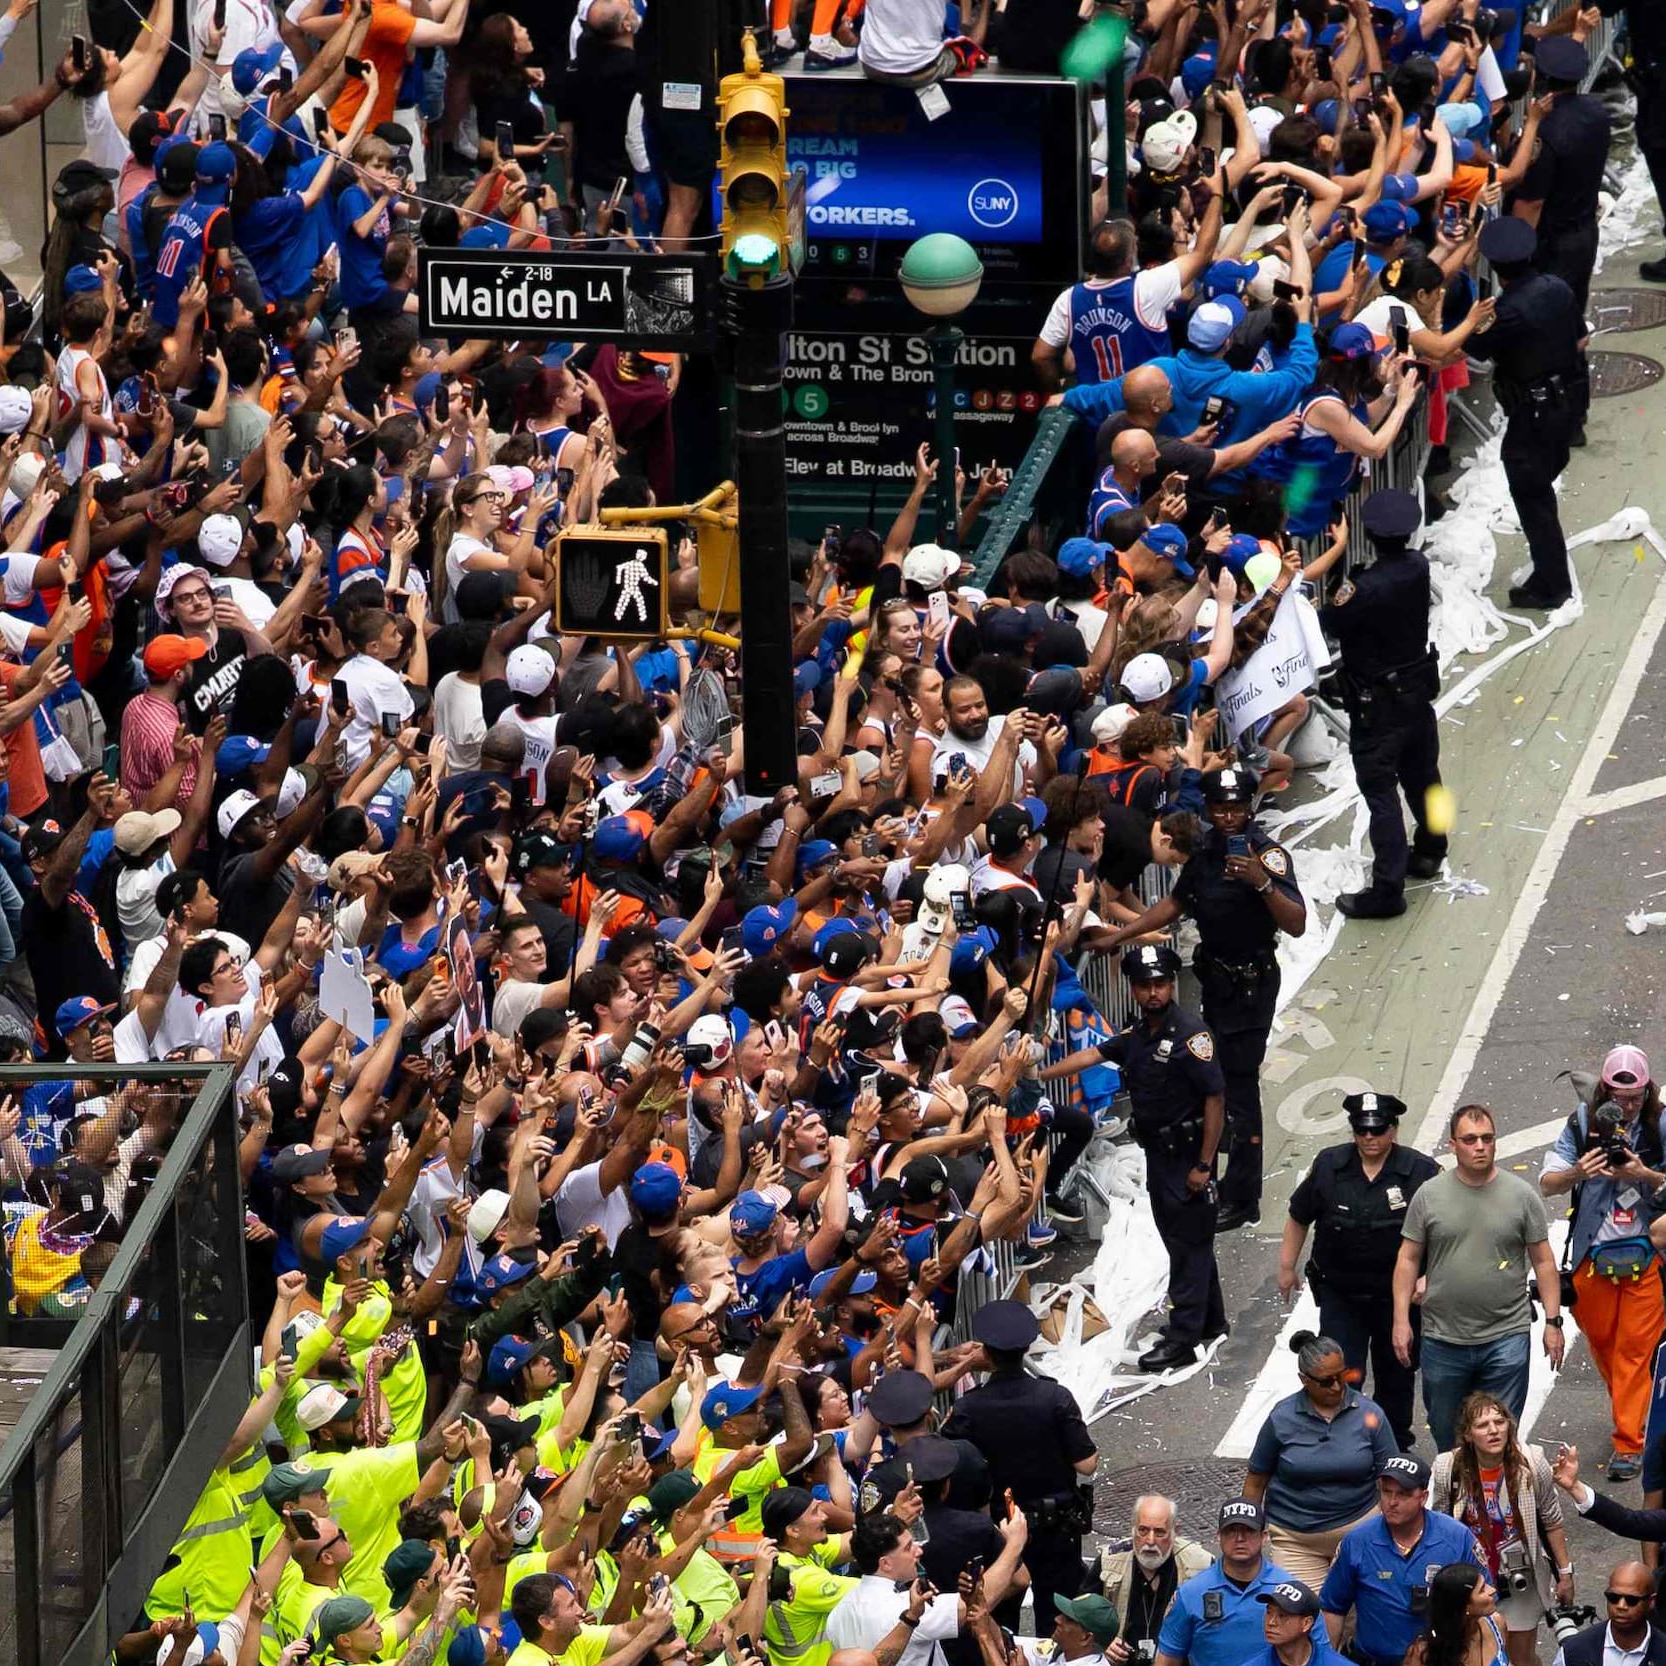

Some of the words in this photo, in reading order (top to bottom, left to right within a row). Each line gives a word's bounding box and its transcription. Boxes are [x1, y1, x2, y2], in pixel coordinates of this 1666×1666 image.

[788, 138, 859, 156] REAM
[815, 160, 858, 178] BIG
[973, 195, 1011, 211] SUNY
[156, 238, 184, 278] 11
[525, 266, 553, 282] 2-18
[439, 275, 578, 321] Maiden
[586, 280, 614, 304] LA
[1075, 307, 1133, 336] BRUNSON
[787, 333, 847, 363] lton
[859, 337, 892, 363] St
[905, 337, 1016, 366] Stion
[1093, 333, 1123, 382] 11
[783, 366, 823, 381] own
[828, 364, 843, 381] &
[850, 365, 886, 382] The
[892, 366, 936, 383] Bron
[803, 393, 818, 413] 5
[954, 394, 966, 407] C
[979, 394, 988, 408] J
[1001, 394, 1013, 408] Z
[1025, 394, 1036, 408] 2
[952, 411, 1014, 424] assageway
[784, 421, 833, 433] owntown
[849, 423, 899, 436] Broolyn
[787, 433, 824, 442] across
[826, 458, 844, 475] at
[851, 459, 937, 482] Broadw
[969, 462, 1013, 480] Jon
[1222, 1501, 1257, 1519] NYPD
